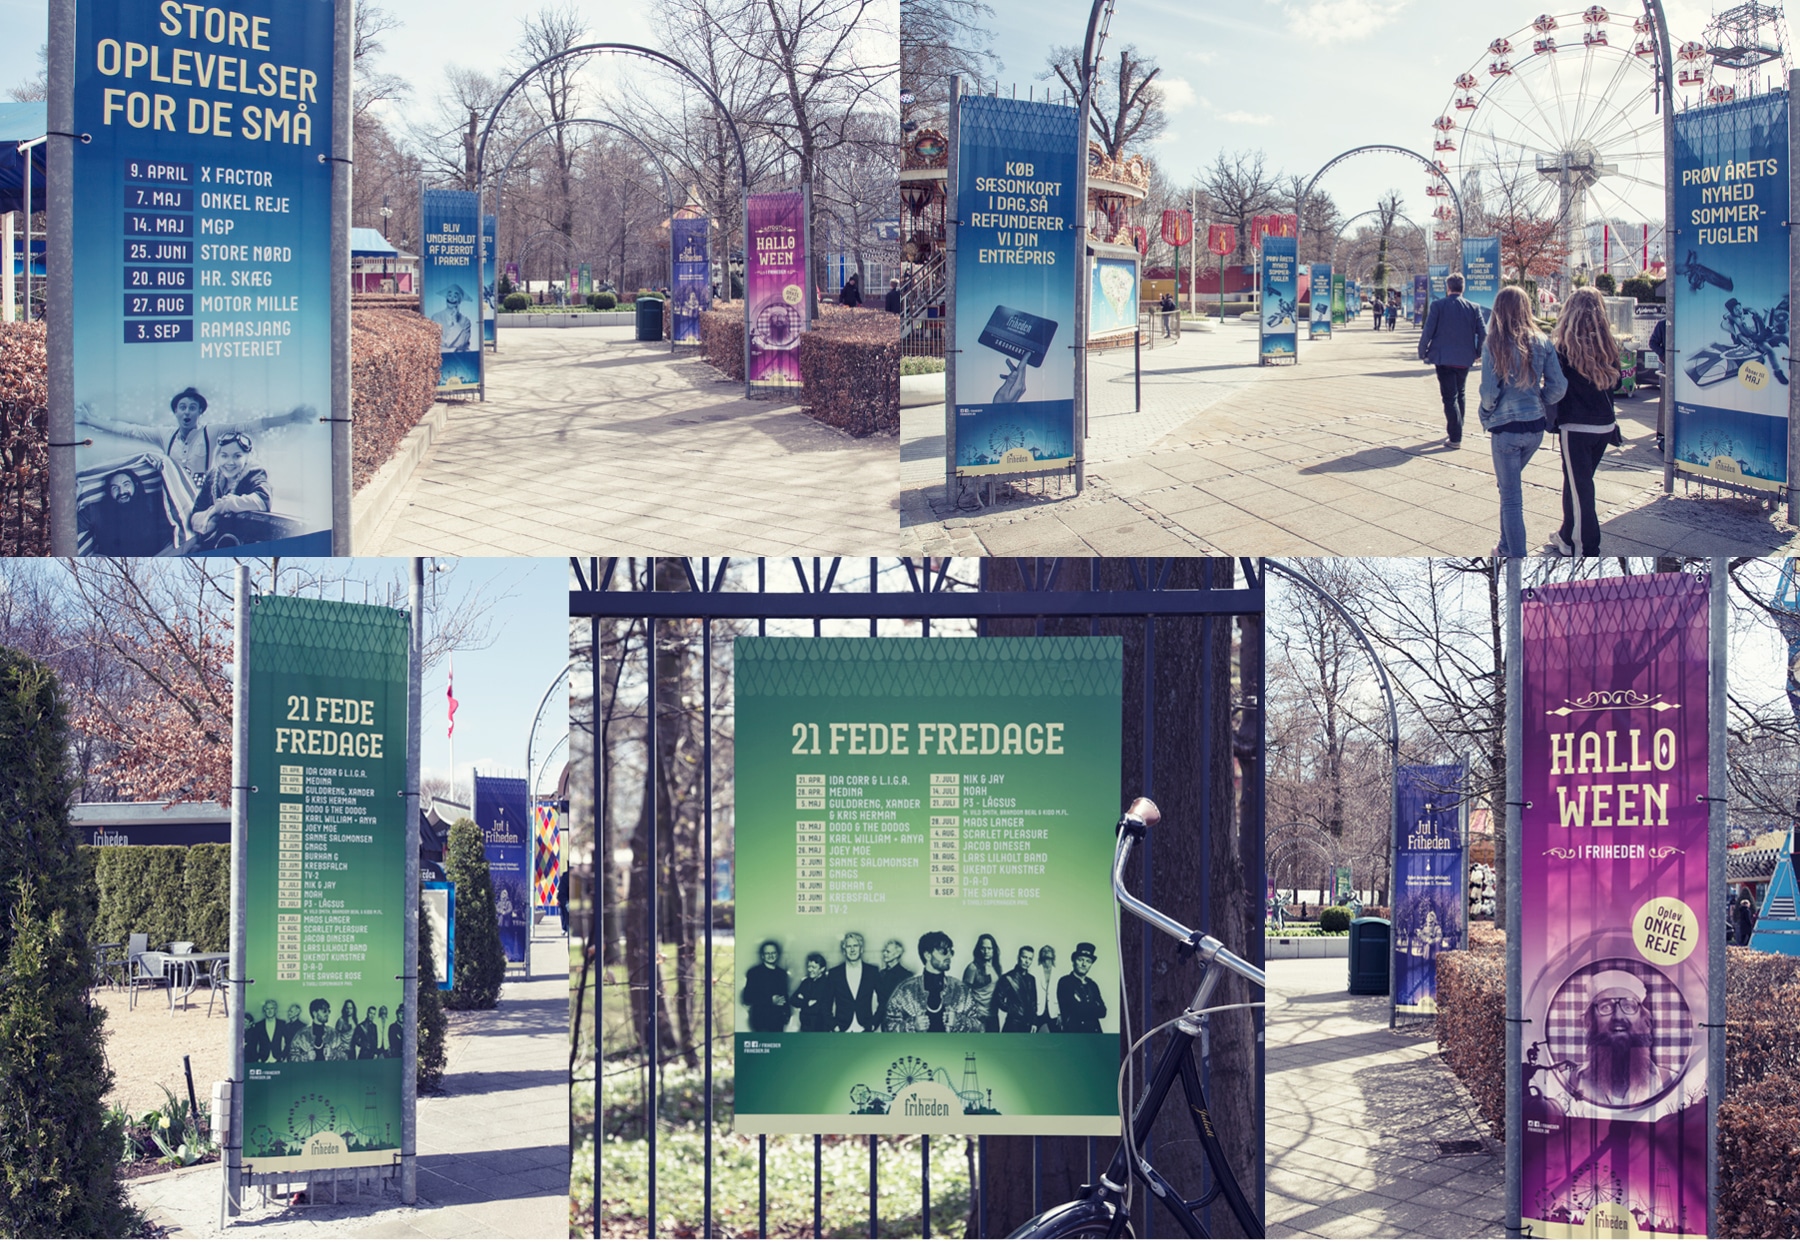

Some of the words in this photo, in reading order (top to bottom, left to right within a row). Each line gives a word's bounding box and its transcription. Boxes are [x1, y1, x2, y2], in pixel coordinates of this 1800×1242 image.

[160, 1, 270, 52] STORE
[97, 38, 318, 104] OPLEVELSER
[104, 88, 176, 132] FOR
[188, 98, 233, 138] DE
[242, 103, 312, 146] SMÅ
[130, 164, 142, 178] 9.
[148, 165, 188, 182] APRIL
[1006, 161, 1034, 177] KØB
[1682, 165, 1721, 186] PRØV
[1725, 158, 1778, 181] ÅRETS
[201, 166, 210, 183] X
[216, 168, 273, 188] FACTOR
[976, 177, 1062, 196] SÆSONKORT
[1702, 183, 1754, 204] NYHED
[137, 191, 150, 206] 7.
[153, 192, 182, 206] MAJ
[201, 194, 250, 212] ONKEL
[255, 197, 290, 214] REJE
[989, 196, 993, 210] I
[972, 212, 1064, 231] REFUNDERER
[1691, 204, 1766, 225] SOMMER-
[133, 218, 152, 232] 14.
[156, 218, 184, 234] MAJ
[201, 219, 234, 236] MGP
[443, 223, 460, 233] BLIV
[426, 234, 476, 244] UNDERHOLDT
[998, 232, 1010, 246] VI
[1015, 232, 1038, 247] DIN
[1699, 225, 1758, 245] FUGLEN
[429, 245, 440, 254] AF
[441, 245, 474, 255] PJERROT
[756, 236, 796, 250] HALLO
[131, 245, 151, 260] 25.
[156, 246, 187, 260] JUNI
[201, 245, 248, 262] STORE
[253, 246, 292, 264] NØRD
[759, 252, 794, 266] WEEN
[979, 247, 1055, 265] ENTRÉPRIS
[434, 256, 437, 265] I
[439, 256, 469, 266] PARKEN
[132, 272, 153, 286] 20.
[158, 271, 186, 286] AUG
[201, 272, 226, 286] HR.
[232, 271, 272, 288] SKÆG
[134, 298, 153, 313] 27.
[157, 298, 185, 313] AUG
[201, 296, 252, 314] MOTOR
[257, 296, 299, 312] MILLE
[138, 325, 150, 340] 3.
[154, 324, 181, 340] SEP
[201, 321, 292, 338] RAMASJANG
[1006, 316, 1032, 333] friheden
[201, 341, 282, 358] MYSTERIET
[287, 695, 310, 722] 21
[316, 697, 374, 725] FEDE
[276, 728, 383, 759] FREDAGE
[792, 723, 821, 754] 21
[829, 723, 909, 754] FEDE
[918, 723, 1064, 754] FREDAGE
[1550, 727, 1676, 775] HALLO
[306, 767, 317, 776] IDA
[319, 768, 337, 776] CORR
[963, 774, 978, 784] NIK
[988, 774, 1005, 784] JAY
[306, 777, 332, 785] MEDINA
[829, 776, 844, 785] IDA
[846, 776, 869, 785] CORR
[880, 776, 910, 785] L.I.G.A.
[829, 788, 863, 797] MEDINA
[963, 786, 987, 796] NOAH
[886, 799, 920, 809] XANDER
[963, 798, 974, 808] P3
[1556, 783, 1669, 828] WEEN
[837, 811, 857, 820] KRIS
[860, 811, 896, 820] HERMAN
[963, 818, 988, 827] MADS
[990, 818, 1024, 827] LANGER
[492, 820, 504, 831] Jul
[830, 822, 852, 832] DODO
[863, 822, 878, 832] THE
[881, 822, 910, 832] DODOS
[1416, 820, 1431, 835] Jul
[1434, 821, 1438, 834] i
[486, 831, 518, 843] Friheden
[829, 834, 852, 844] KARL
[855, 834, 891, 844] WILLIAM
[901, 834, 924, 844] ANYA
[963, 829, 1001, 839] SCARLET
[1004, 829, 1048, 839] PLEASURE
[963, 841, 990, 851] JACOB
[994, 841, 1030, 851] DINESEN
[1408, 835, 1450, 850] Friheden
[829, 846, 851, 855] JOEY
[853, 846, 871, 855] MOE
[963, 853, 985, 863] LARS
[988, 853, 1021, 863] LILHOLT
[1024, 853, 1048, 863] BAND
[1578, 846, 1582, 859] I
[1586, 845, 1645, 859] FRIHEDEN
[304, 862, 348, 870] KREBSFALCH
[829, 858, 858, 867] SANNE
[861, 858, 919, 867] SALOMONSEN
[963, 865, 997, 874] UKENDT
[1000, 865, 1045, 874] KUNSTNER
[829, 869, 858, 879] GNAGS
[829, 881, 865, 891] BURHAN
[963, 888, 979, 898] THE
[982, 888, 1015, 898] SAVAGE
[1018, 888, 1040, 898] ROSE
[1658, 906, 1682, 921] Oplev
[1644, 916, 1686, 941] ONKEL
[1645, 934, 1679, 956] REJE
[905, 1098, 949, 1116] friheden
[311, 1142, 339, 1155] friheden
[1595, 1214, 1628, 1230] friheden
